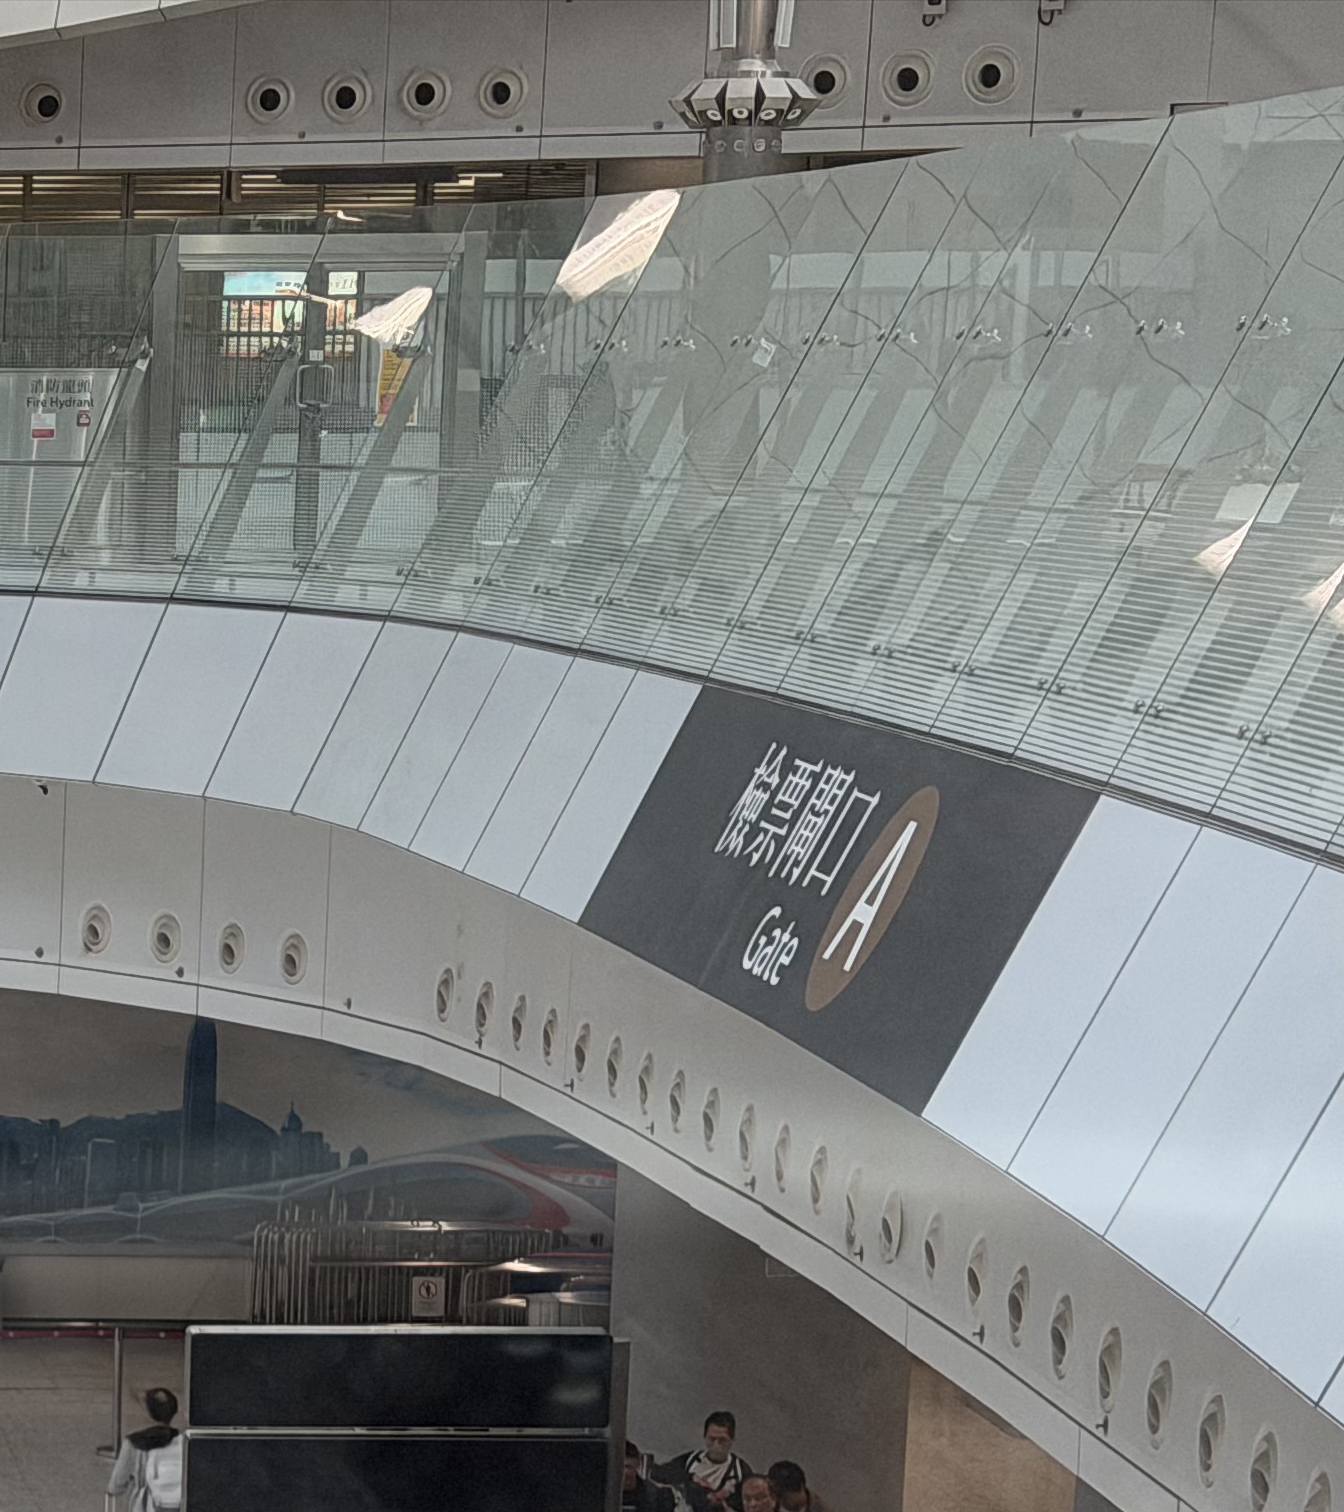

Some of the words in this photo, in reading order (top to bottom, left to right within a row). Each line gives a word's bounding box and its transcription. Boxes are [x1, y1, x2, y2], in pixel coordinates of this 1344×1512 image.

[26, 397, 46, 408] Fire
[49, 397, 94, 410] Hydrant
[713, 741, 881, 897] 檢票閘口
[742, 905, 799, 986] Gate
[822, 820, 918, 972] A
